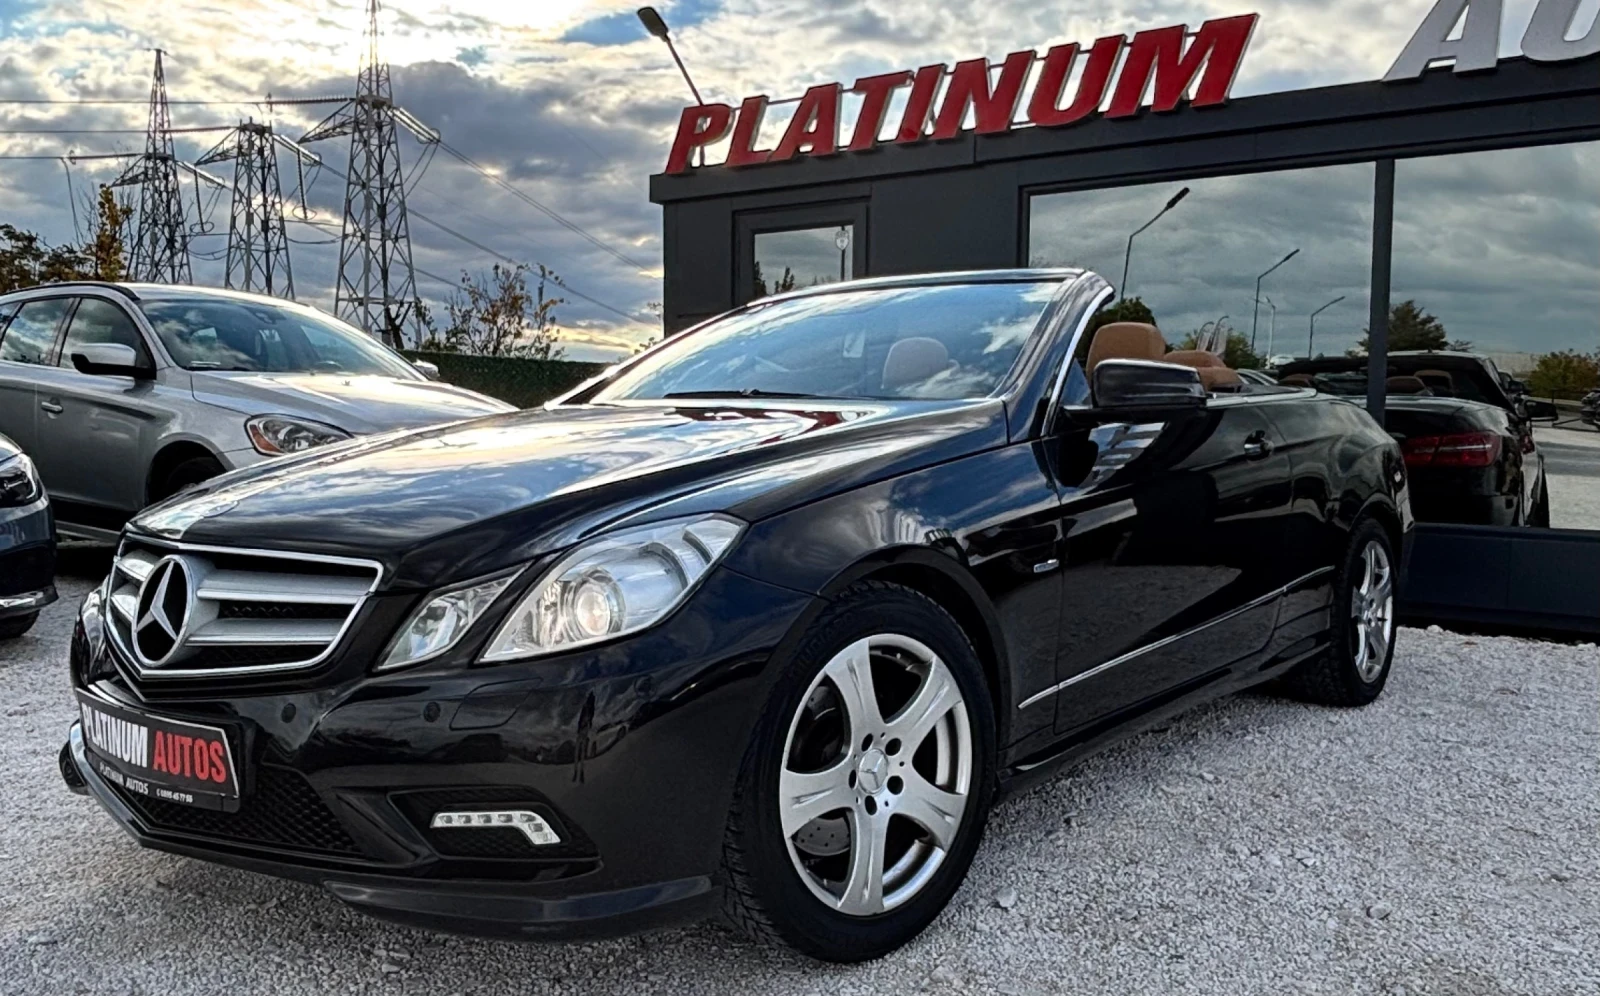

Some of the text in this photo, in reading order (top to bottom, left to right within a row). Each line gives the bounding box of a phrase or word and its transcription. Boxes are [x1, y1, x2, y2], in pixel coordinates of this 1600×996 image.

[665, 13, 1260, 175] PLATINUM
[81, 702, 226, 783] PLATINUM AUTOS
[126, 777, 148, 795] AUTOS
